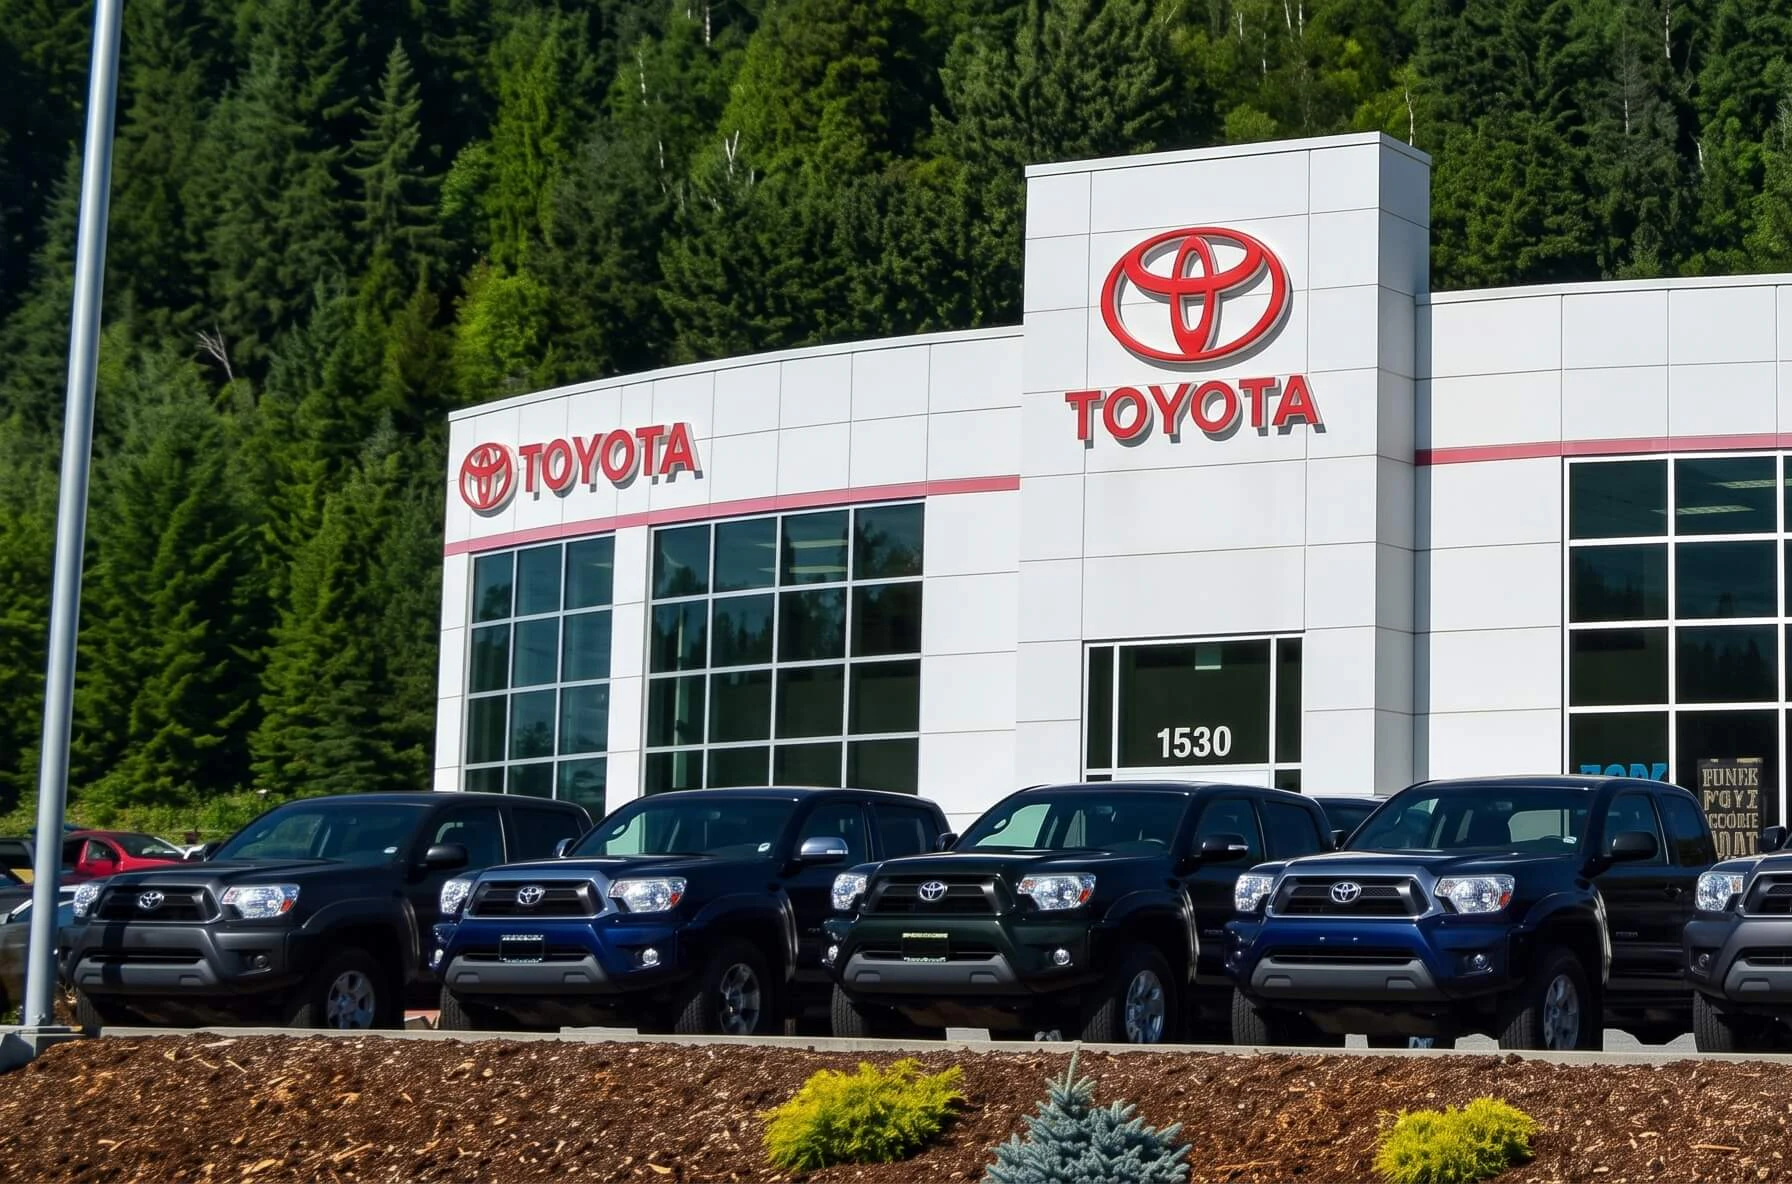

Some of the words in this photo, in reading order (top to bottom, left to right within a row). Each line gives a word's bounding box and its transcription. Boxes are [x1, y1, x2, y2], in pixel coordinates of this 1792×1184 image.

[1064, 374, 1322, 442] TOYOTA
[518, 421, 699, 495] TOYOTA
[1157, 725, 1232, 758] 1530
